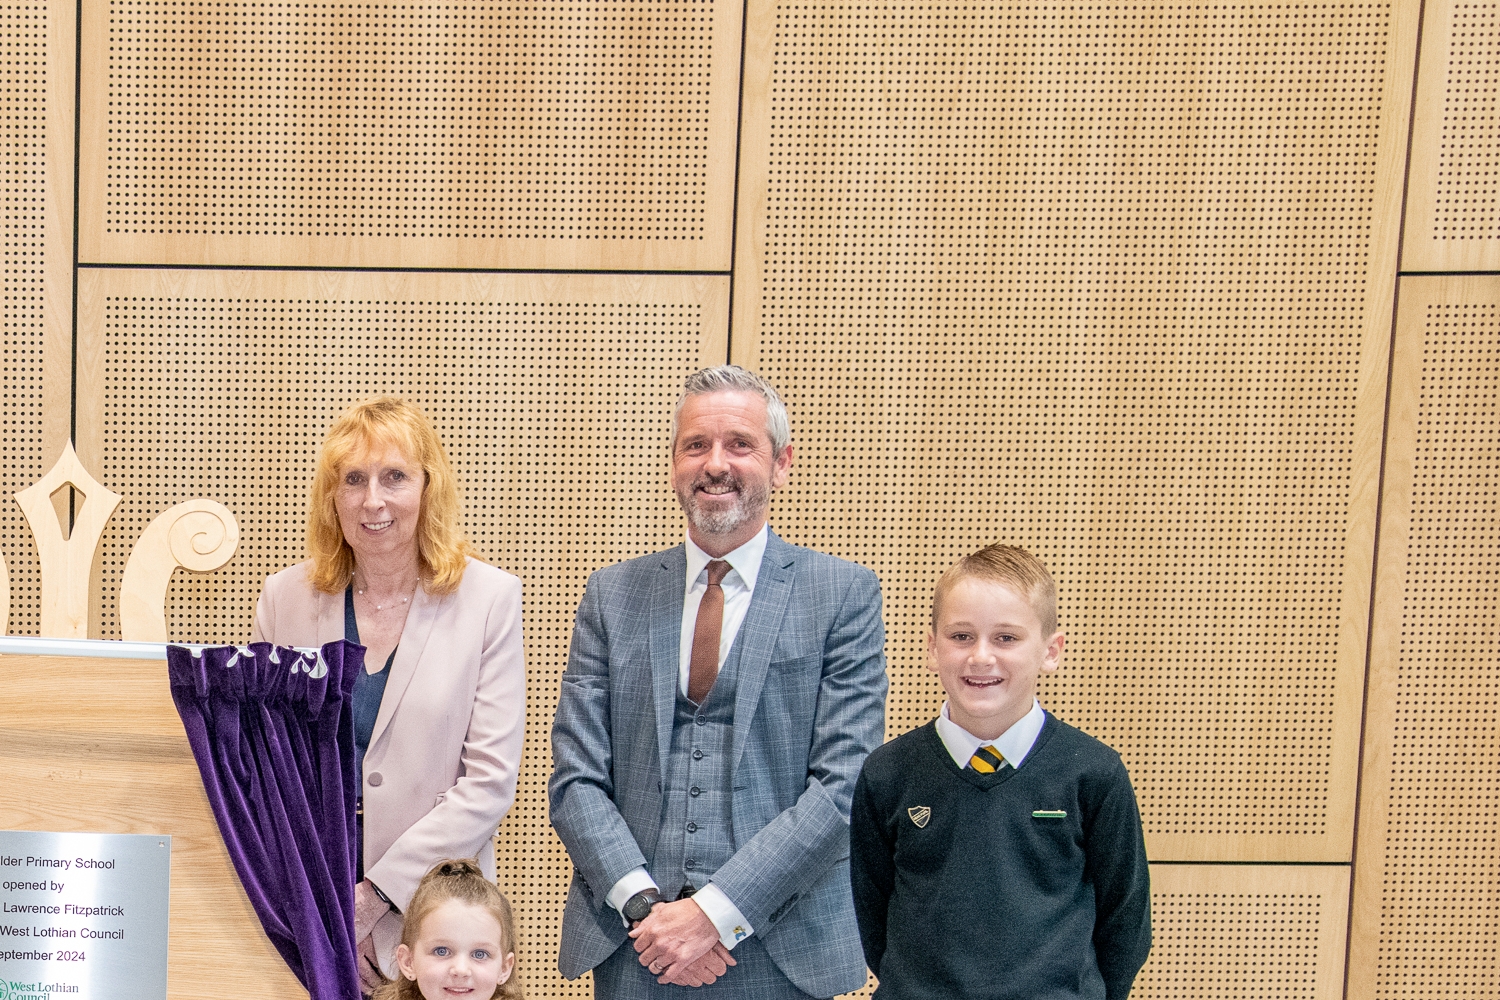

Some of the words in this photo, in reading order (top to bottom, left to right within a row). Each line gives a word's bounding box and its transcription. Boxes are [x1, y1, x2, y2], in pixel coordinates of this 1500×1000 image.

[26, 856, 71, 870] Primary
[75, 857, 115, 869] School
[2, 880, 46, 892] opened
[50, 880, 64, 893] by
[3, 902, 60, 914] Lawrence
[64, 904, 124, 917] Fitzpatrick
[0, 925, 30, 937] West
[33, 926, 76, 938] Lothian
[80, 927, 124, 939] Council
[56, 950, 86, 961] 2024
[9, 981, 35, 992] West
[38, 982, 79, 993] Lothian
